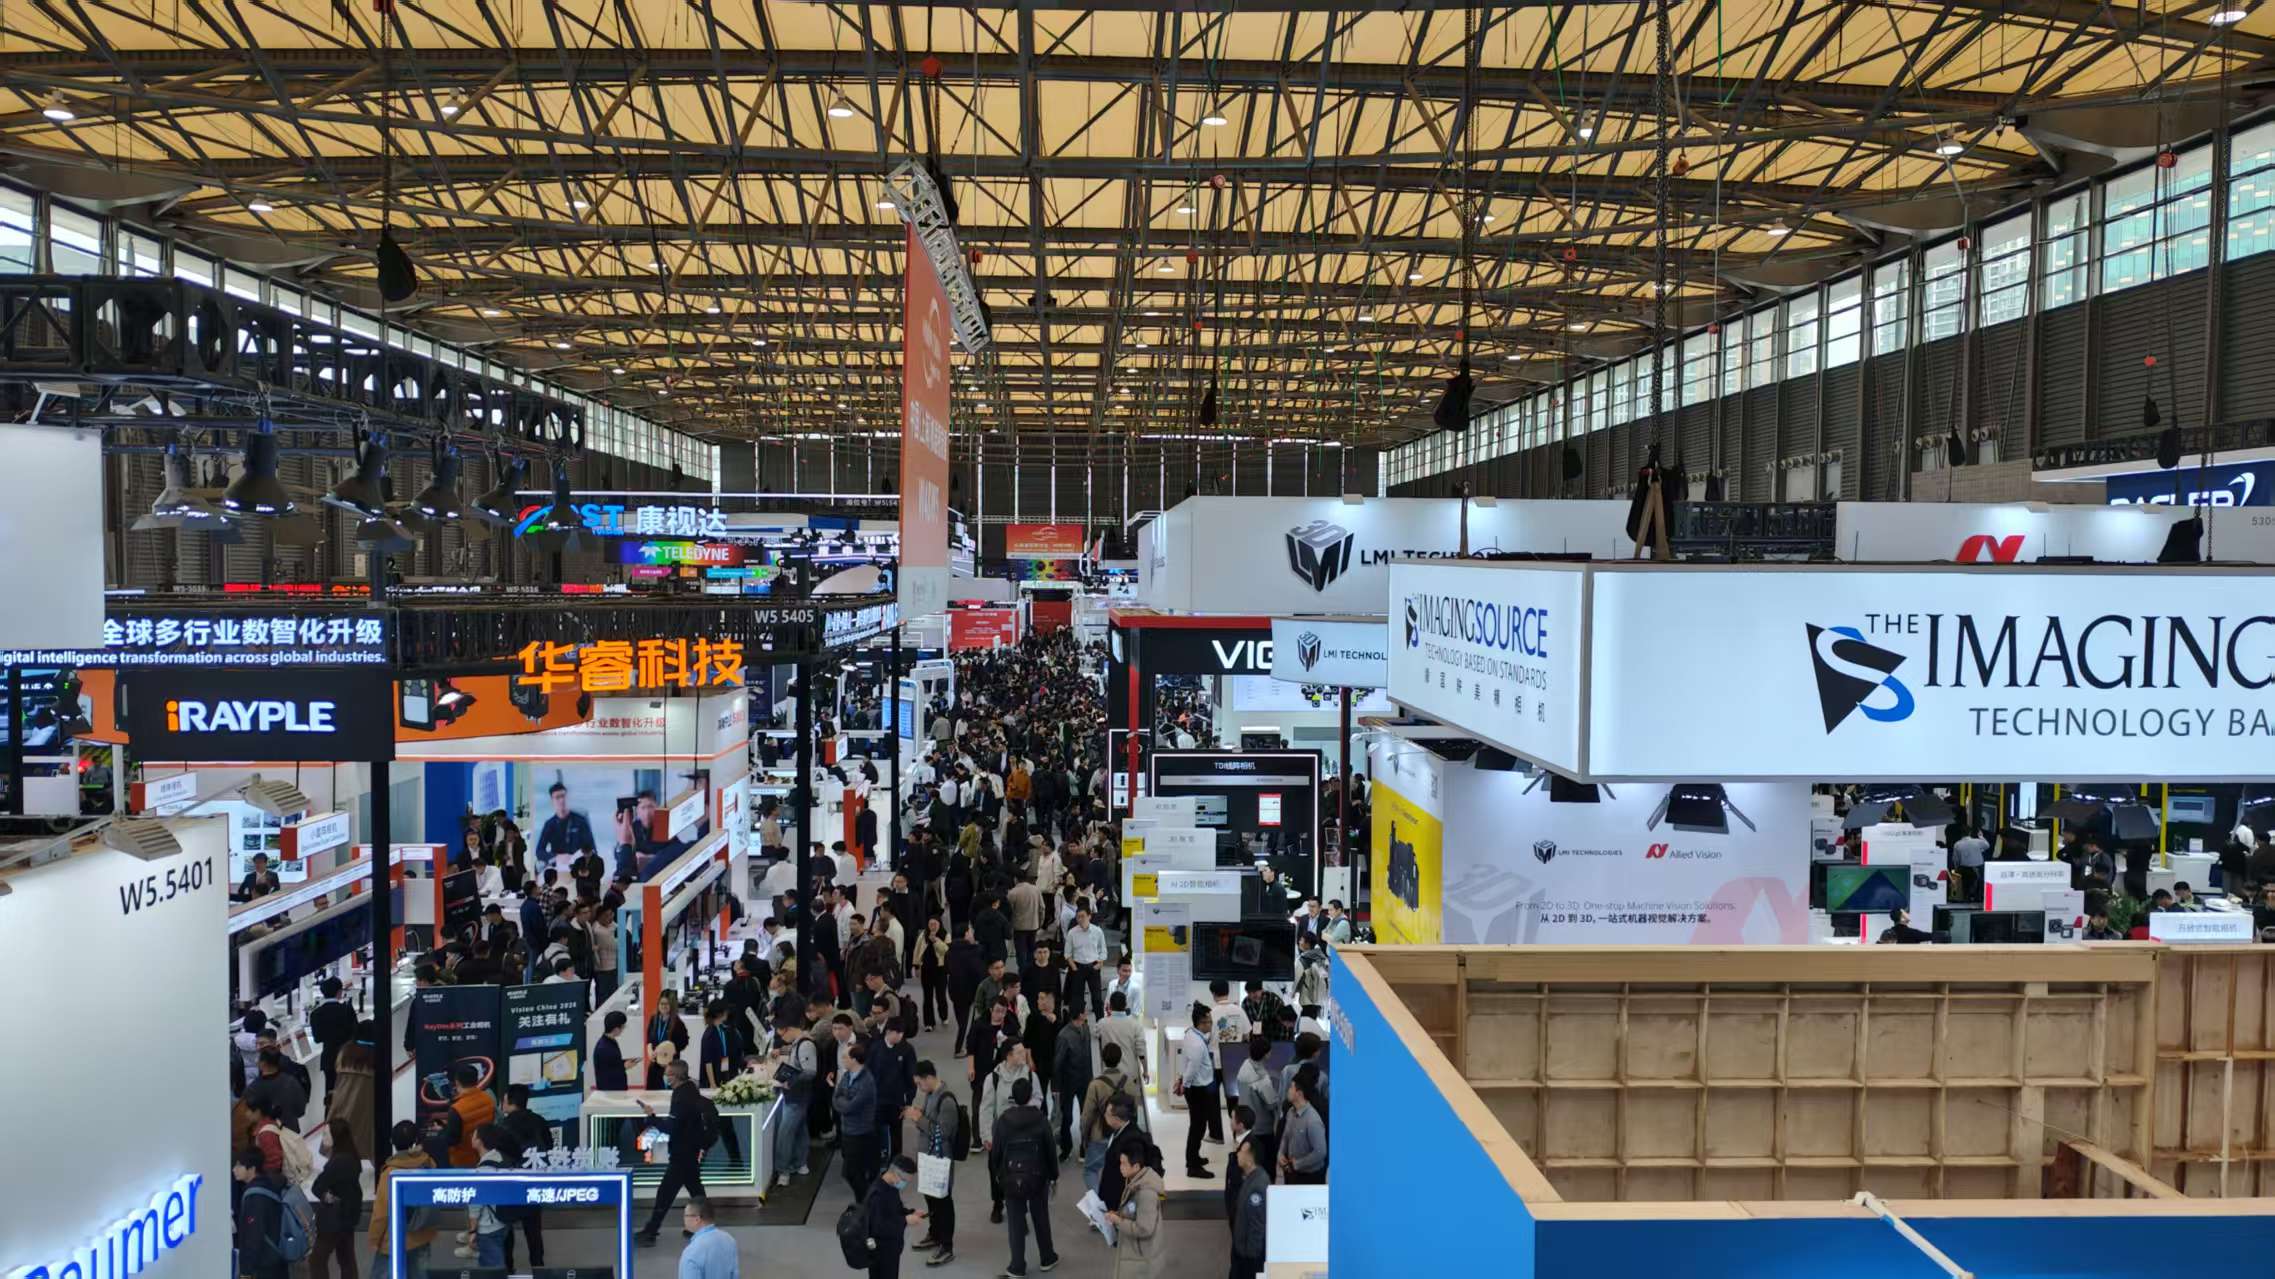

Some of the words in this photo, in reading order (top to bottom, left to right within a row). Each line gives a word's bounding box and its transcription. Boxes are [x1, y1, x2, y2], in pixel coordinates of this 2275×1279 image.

[636, 505, 728, 536] 康视达
[663, 545, 729, 562] TELEDYNE
[754, 610, 778, 624] W5
[781, 610, 815, 624] 5405
[1419, 592, 1549, 658] IMAGINGSOURCE
[1865, 613, 1920, 635] THE
[103, 617, 383, 646] 全球多行业数智化升级
[37, 651, 117, 667] intelligence
[119, 651, 222, 664] transformation
[225, 654, 269, 664] across
[270, 651, 312, 666] global
[315, 651, 387, 664] industries.
[1324, 650, 1338, 659] LMI
[1340, 650, 1387, 661] TECHNOL
[1924, 613, 2275, 690] IMAGING
[517, 637, 744, 694] 华睿科技
[1424, 641, 1463, 668] TECHNOLOGY
[1464, 651, 1486, 674] BASED
[1487, 657, 1499, 677] ON
[1499, 661, 1547, 690] STANDARDS
[165, 700, 336, 733] iRAYPLE
[1968, 707, 2215, 737] TECHNOLOGY
[2227, 708, 2275, 737] BA
[1669, 850, 1694, 859] Allied
[1696, 850, 1722, 859] Vision
[119, 855, 215, 915] W5.5401
[1627, 900, 1664, 910] Machine
[1667, 900, 1691, 910] Vision
[1552, 913, 1565, 923] 2D
[518, 1012, 571, 1029] 关注有礼
[432, 1187, 476, 1203] 高防护
[526, 1186, 600, 1204] 高速/JPEG
